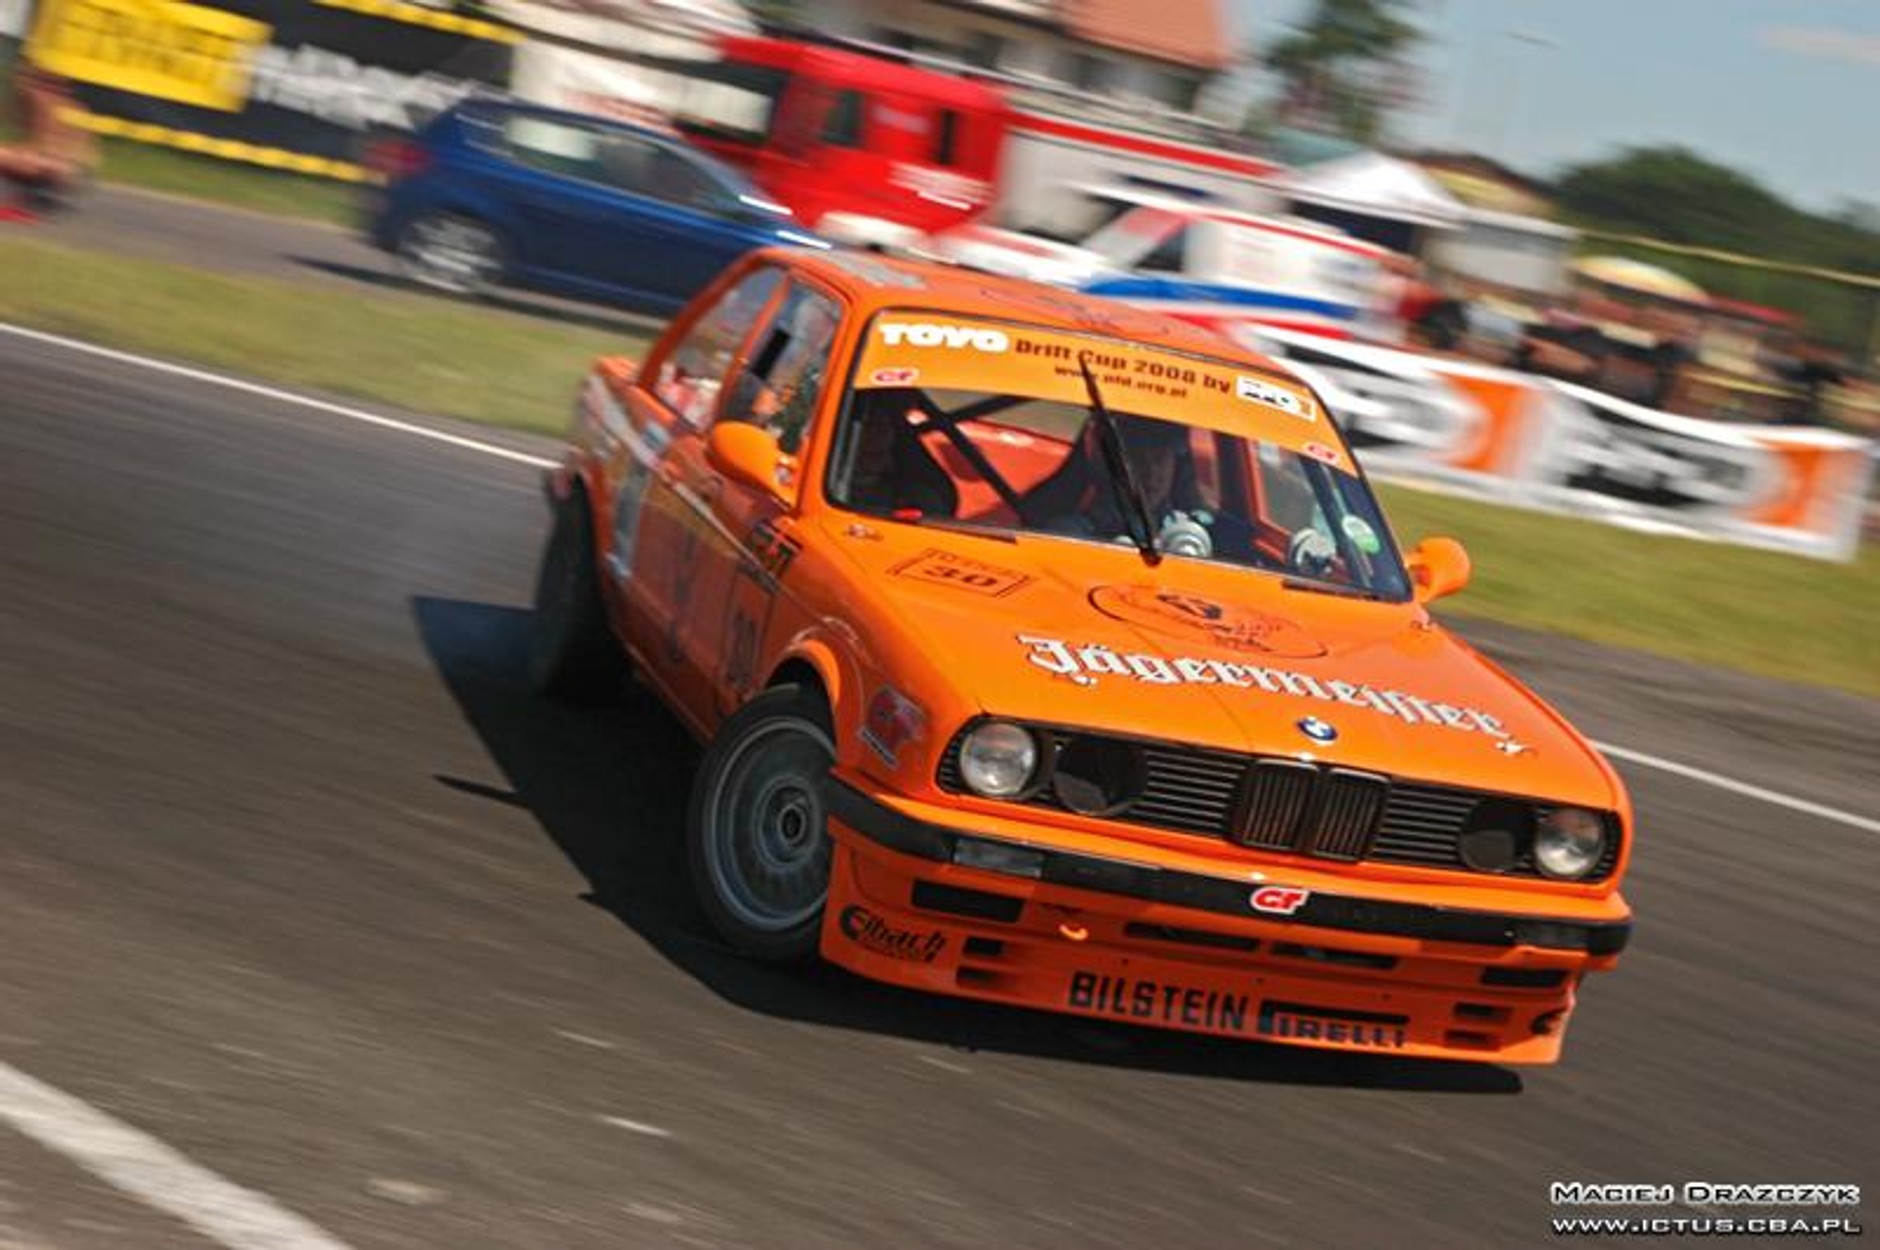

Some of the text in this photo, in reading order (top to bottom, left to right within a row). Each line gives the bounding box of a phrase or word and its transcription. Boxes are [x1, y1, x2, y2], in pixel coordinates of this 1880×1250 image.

[880, 323, 1009, 354] TOYO
[1015, 338, 1231, 395] Drift Cup 2008 by
[1067, 971, 1411, 1049] BILSTEIN PIRELLI
